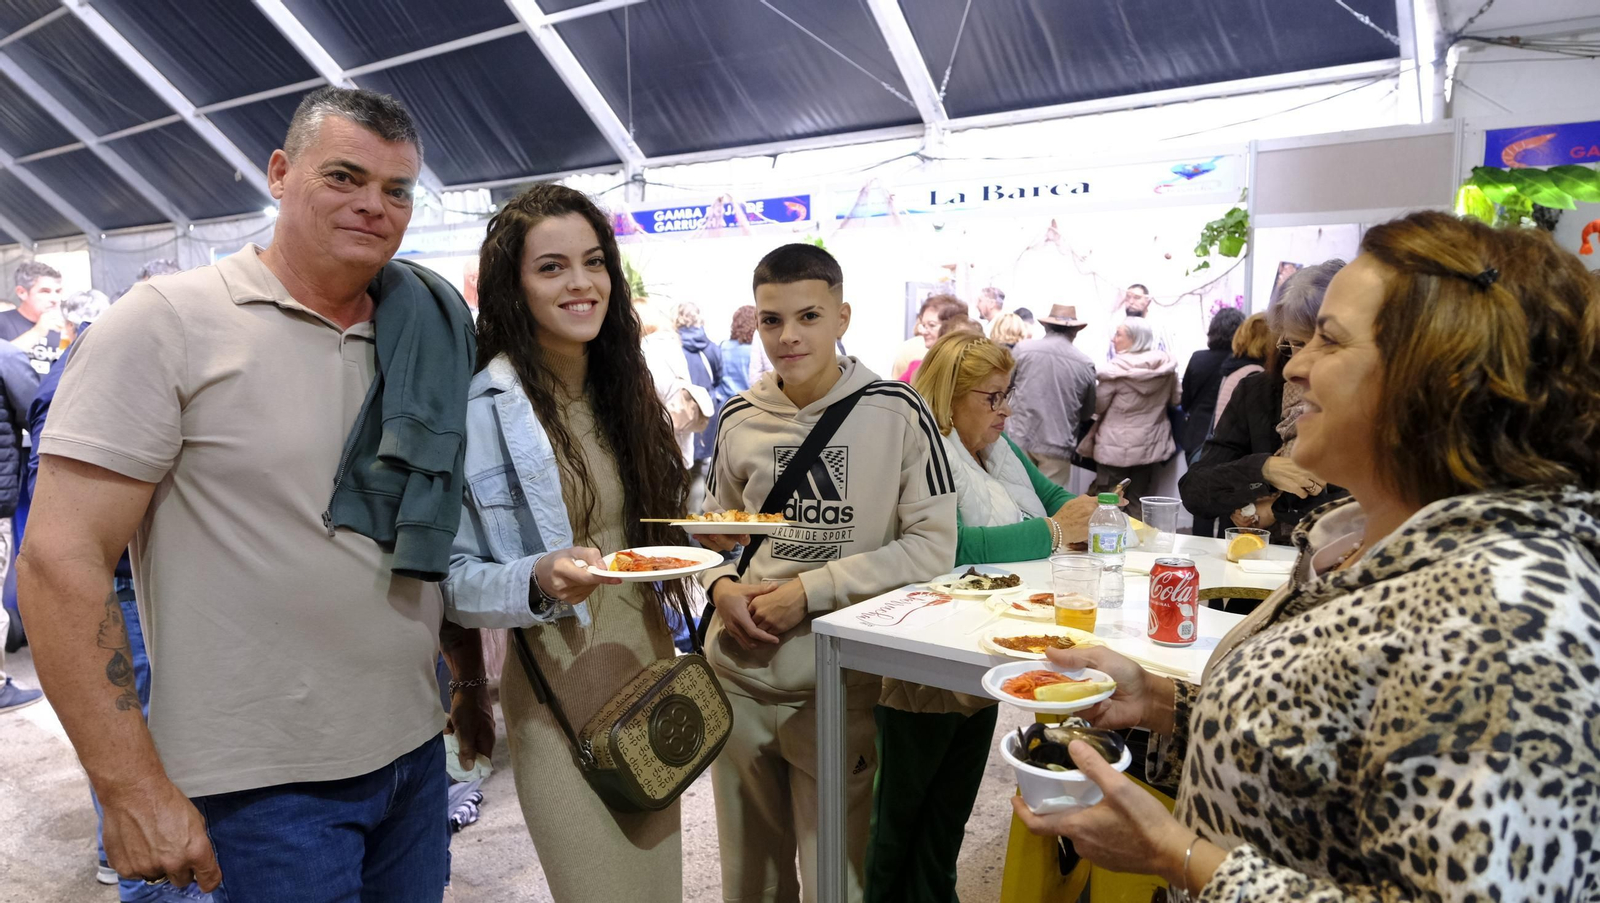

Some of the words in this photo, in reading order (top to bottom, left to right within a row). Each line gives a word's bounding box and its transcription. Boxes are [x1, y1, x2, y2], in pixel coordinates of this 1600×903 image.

[930, 190, 965, 205] La
[982, 181, 1090, 200] Barca
[653, 207, 703, 222] GAMBA
[822, 529, 853, 541] SPORT
